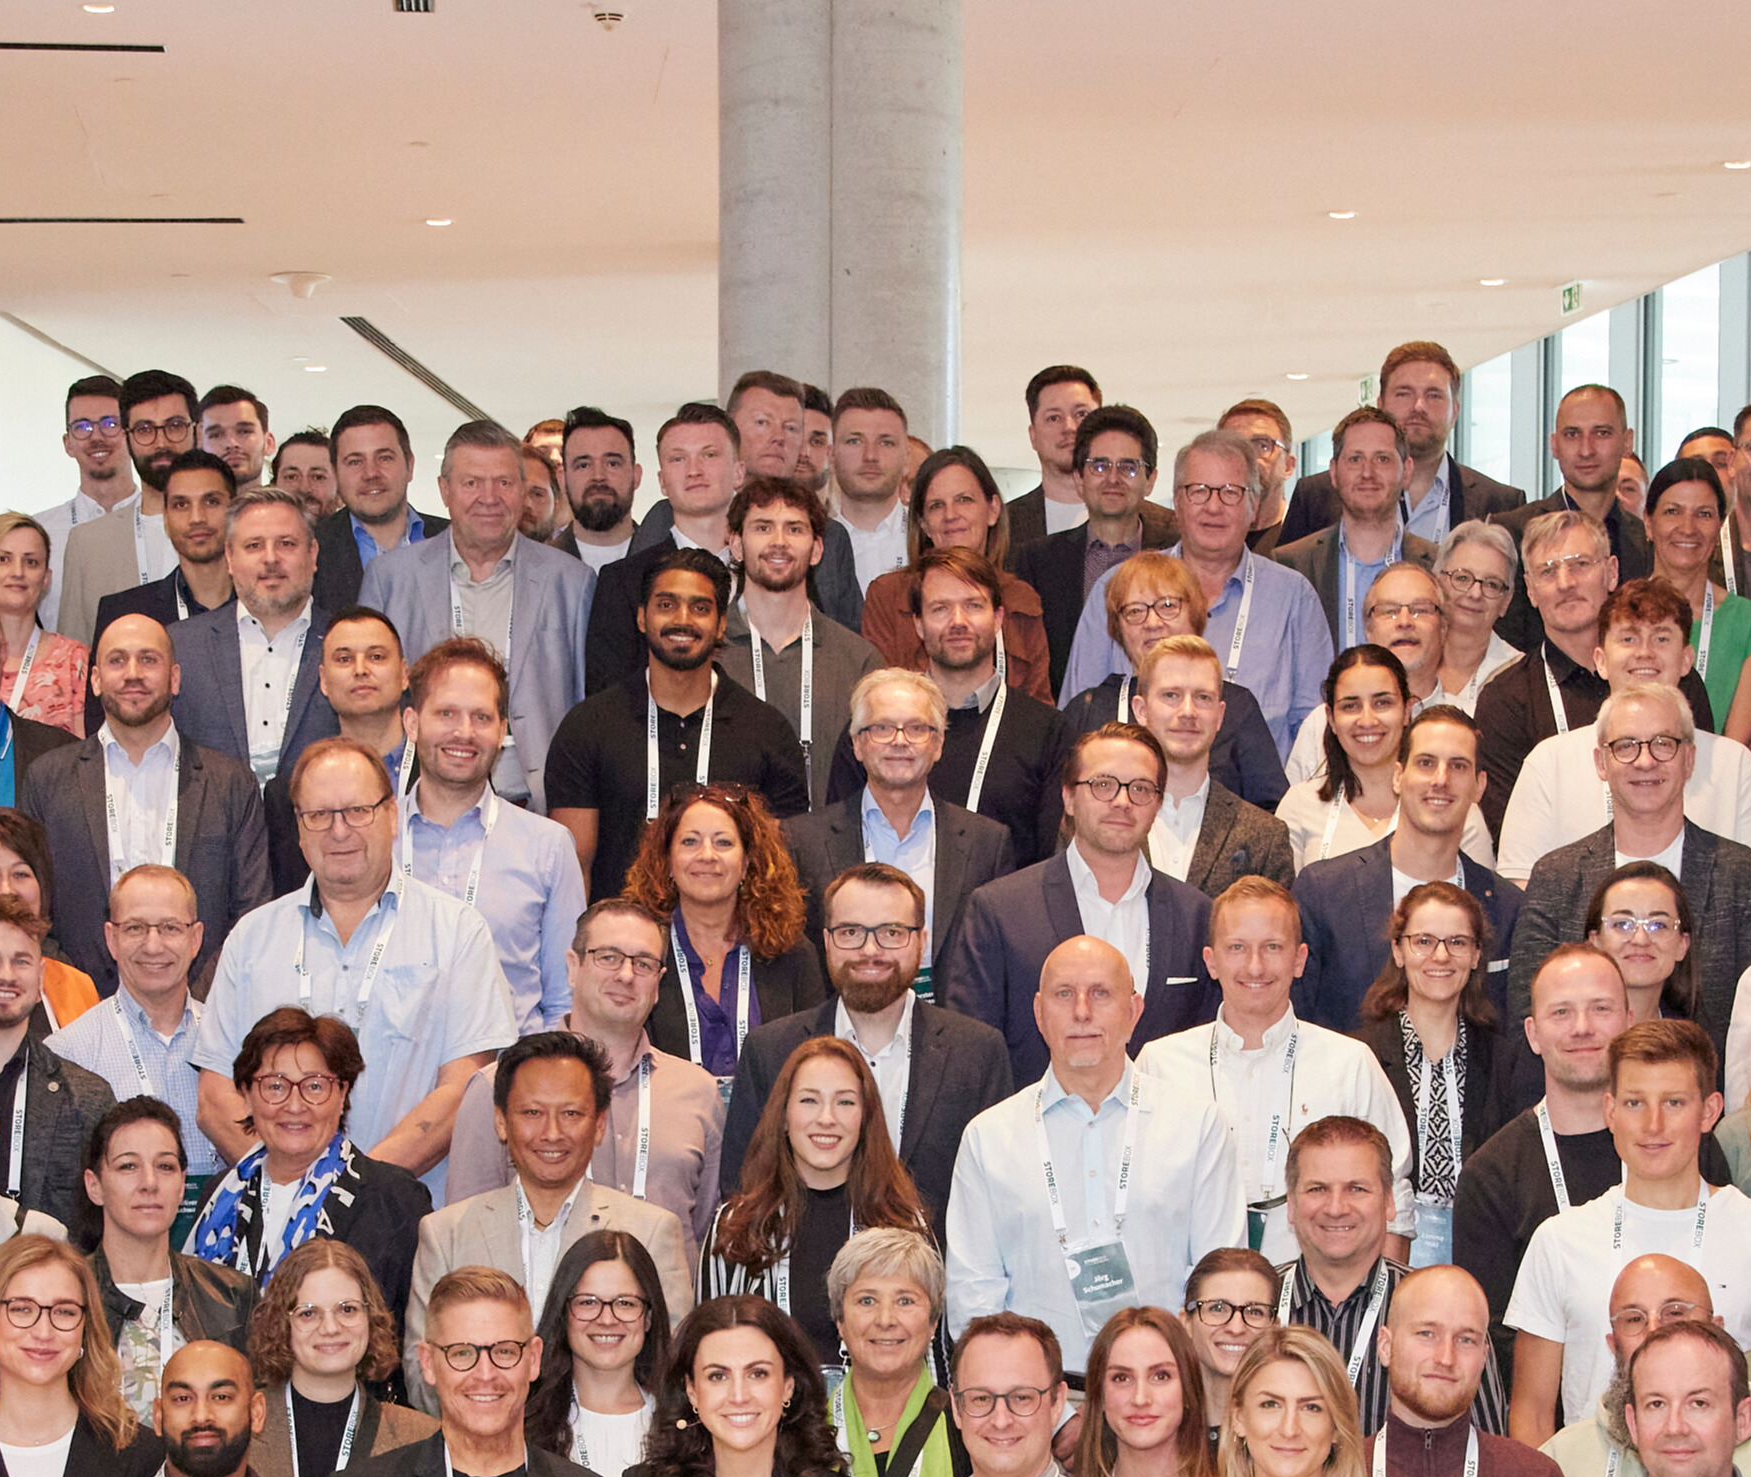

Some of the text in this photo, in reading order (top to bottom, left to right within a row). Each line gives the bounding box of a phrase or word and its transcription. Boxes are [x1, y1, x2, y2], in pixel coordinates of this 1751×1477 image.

[1232, 608, 1247, 650] STOREBOX
[1346, 597, 1355, 634] STOREBOX
[20, 636, 38, 675] STOREBOX
[754, 648, 765, 690] STOREBOX
[802, 668, 812, 709] STOREBOX
[649, 698, 659, 740] STOREBOX
[649, 765, 658, 809] STOREBOX
[972, 749, 988, 791] STOREBOX
[107, 794, 118, 833] STOREBOX
[164, 806, 178, 847] STOREBOX
[363, 942, 385, 981] STOREBOX
[739, 950, 750, 993] STOREBOX
[686, 1000, 699, 1046] STOREBOX
[126, 1038, 148, 1081] STOREBOX
[1282, 1032, 1298, 1074] STOREBOX
[13, 1109, 23, 1153] STOREBOX
[638, 1126, 650, 1174] STOREBOX
[1266, 1114, 1280, 1163] STOREBOX
[1417, 1107, 1428, 1153] STOREBOX
[1042, 1161, 1059, 1206] STOREBOX
[1119, 1144, 1132, 1190] STOREBOX
[1551, 1160, 1568, 1206] STOREBOX
[1613, 1203, 1623, 1251] STOREBOX
[1693, 1200, 1706, 1249] STOREBOX
[1083, 1278, 1125, 1294] Schumacher
[1094, 1272, 1110, 1285] Jörg
[1366, 1270, 1388, 1313] STOREBOX
[161, 1286, 172, 1332] STOREBOX
[341, 1407, 360, 1457] STOREBOX
